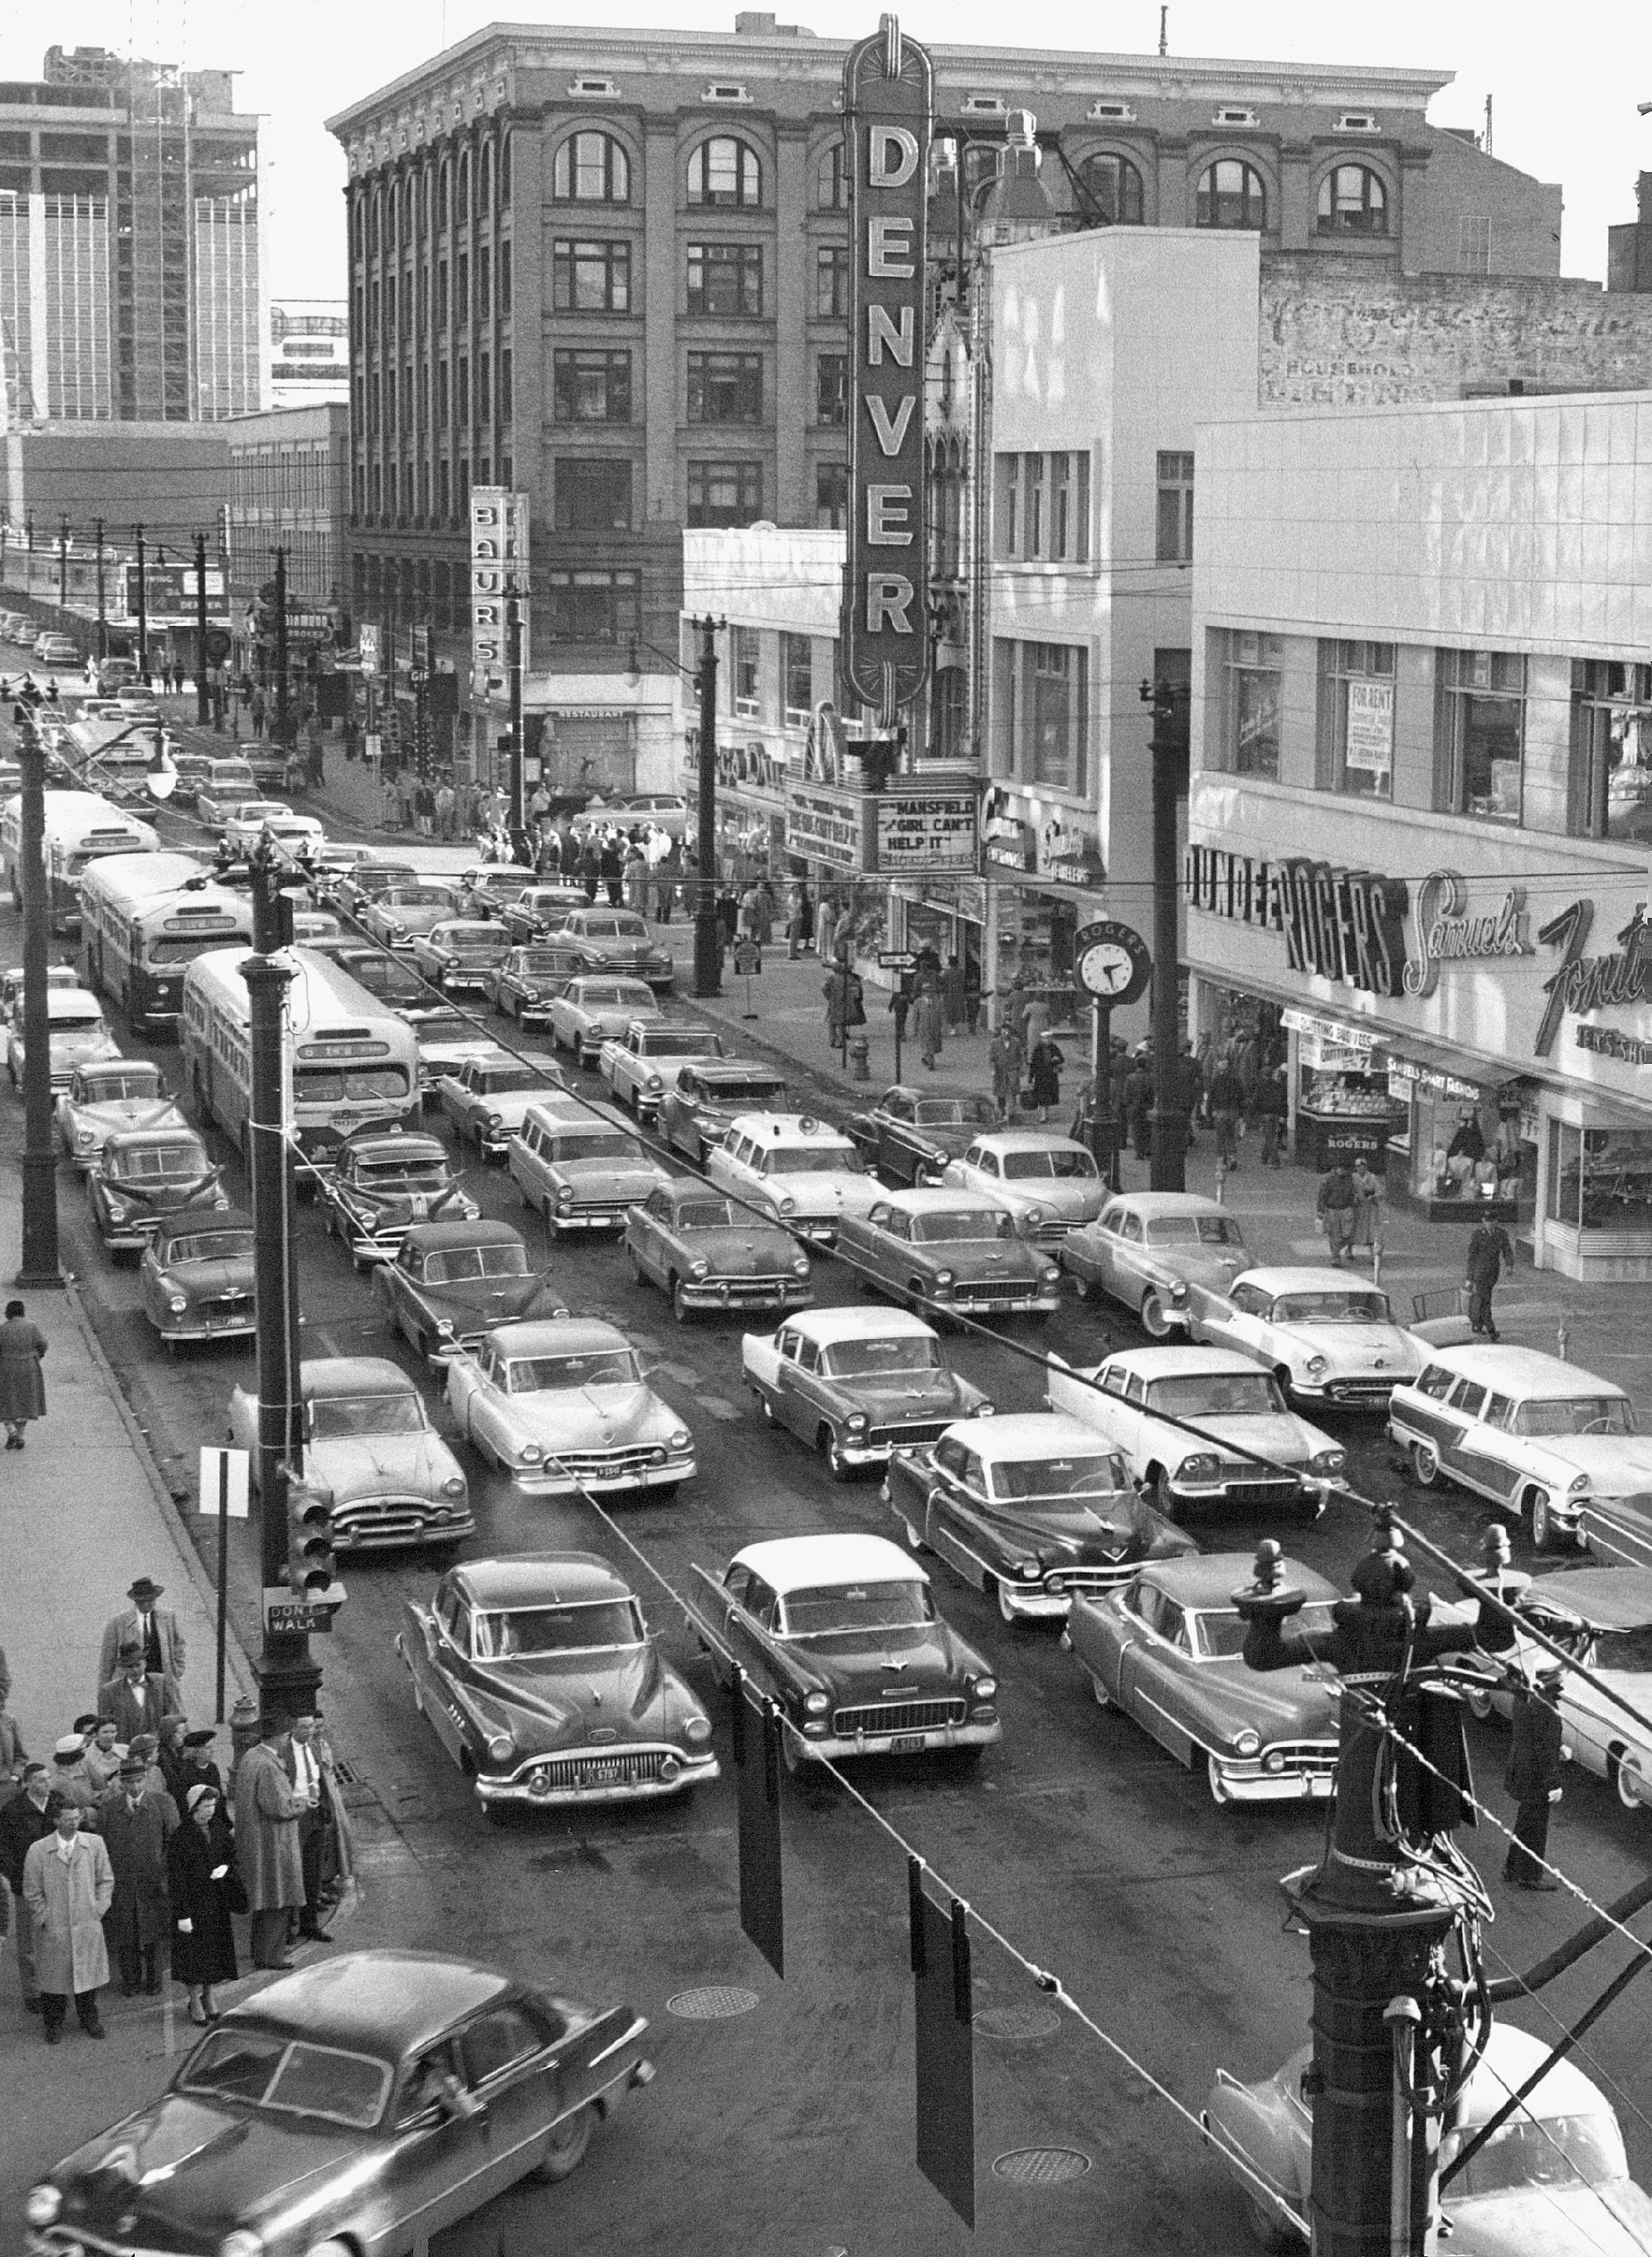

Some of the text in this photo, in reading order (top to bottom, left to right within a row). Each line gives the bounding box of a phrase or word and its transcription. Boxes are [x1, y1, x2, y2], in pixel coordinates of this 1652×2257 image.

[865, 125, 920, 634] DENVER
[898, 799, 974, 815] MANSFIELD
[898, 818, 928, 831] GIRL
[887, 837, 924, 850] HELP
[1278, 859, 1393, 997] ROGERS
[1402, 871, 1525, 996] Samuels
[1081, 924, 1144, 955] ROGERS
[1327, 1139, 1378, 1150] ROGERS
[272, 1617, 316, 1631] WALK
